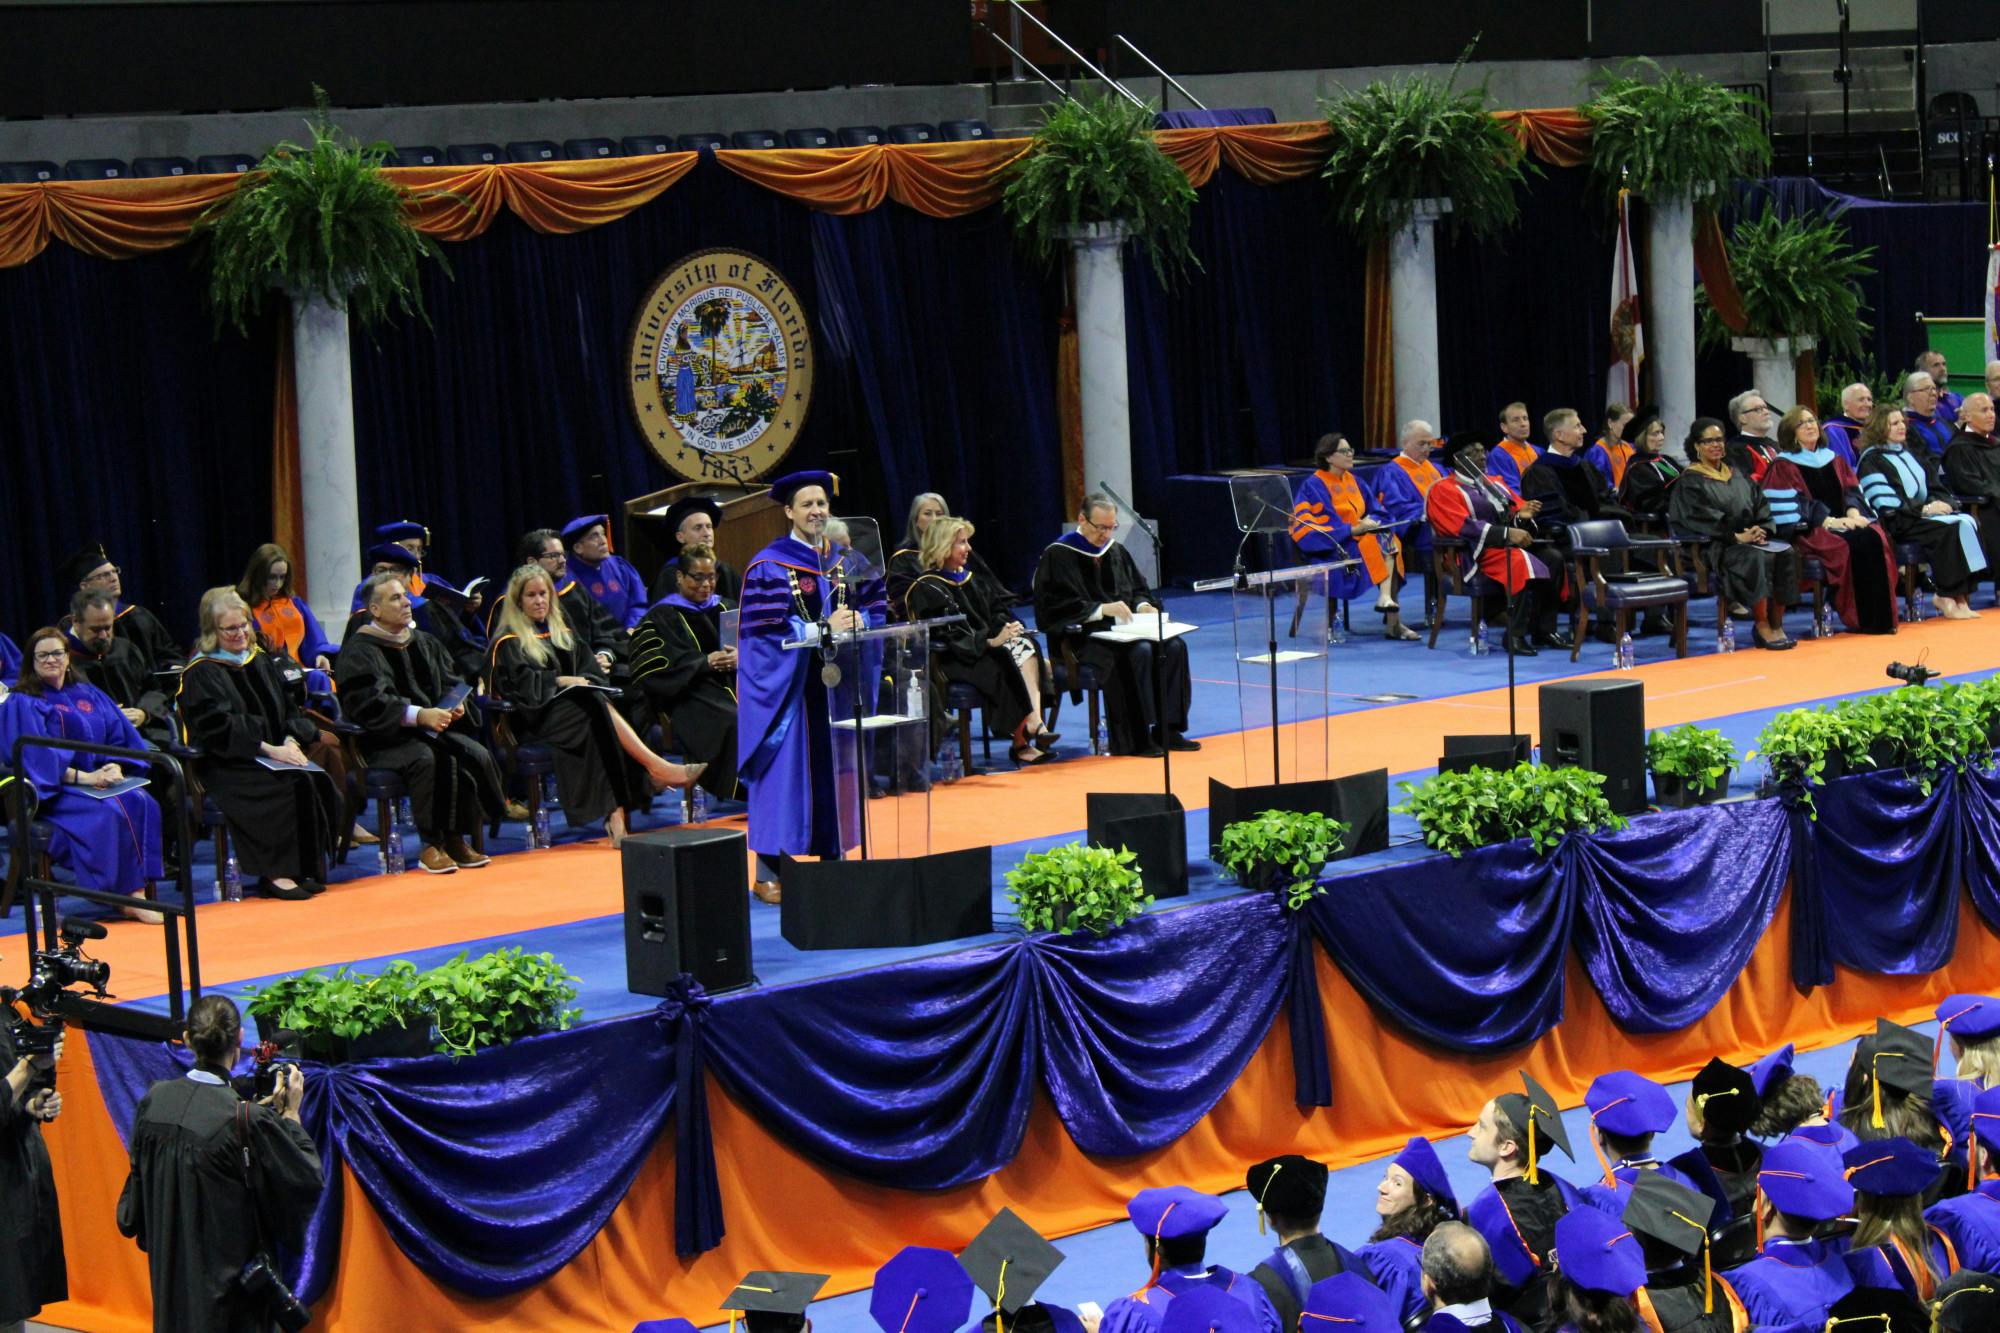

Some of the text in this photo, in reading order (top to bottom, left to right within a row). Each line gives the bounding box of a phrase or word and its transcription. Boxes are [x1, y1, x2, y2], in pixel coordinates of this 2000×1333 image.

[635, 261, 807, 382] University of Florida
[658, 331, 673, 372] CIVIUM
[671, 319, 680, 331] IN
[678, 289, 716, 319] MORIBUS
[718, 288, 734, 298] REI
[771, 327, 787, 364] SALUS
[686, 424, 764, 450] IN GOD WE TRUST
